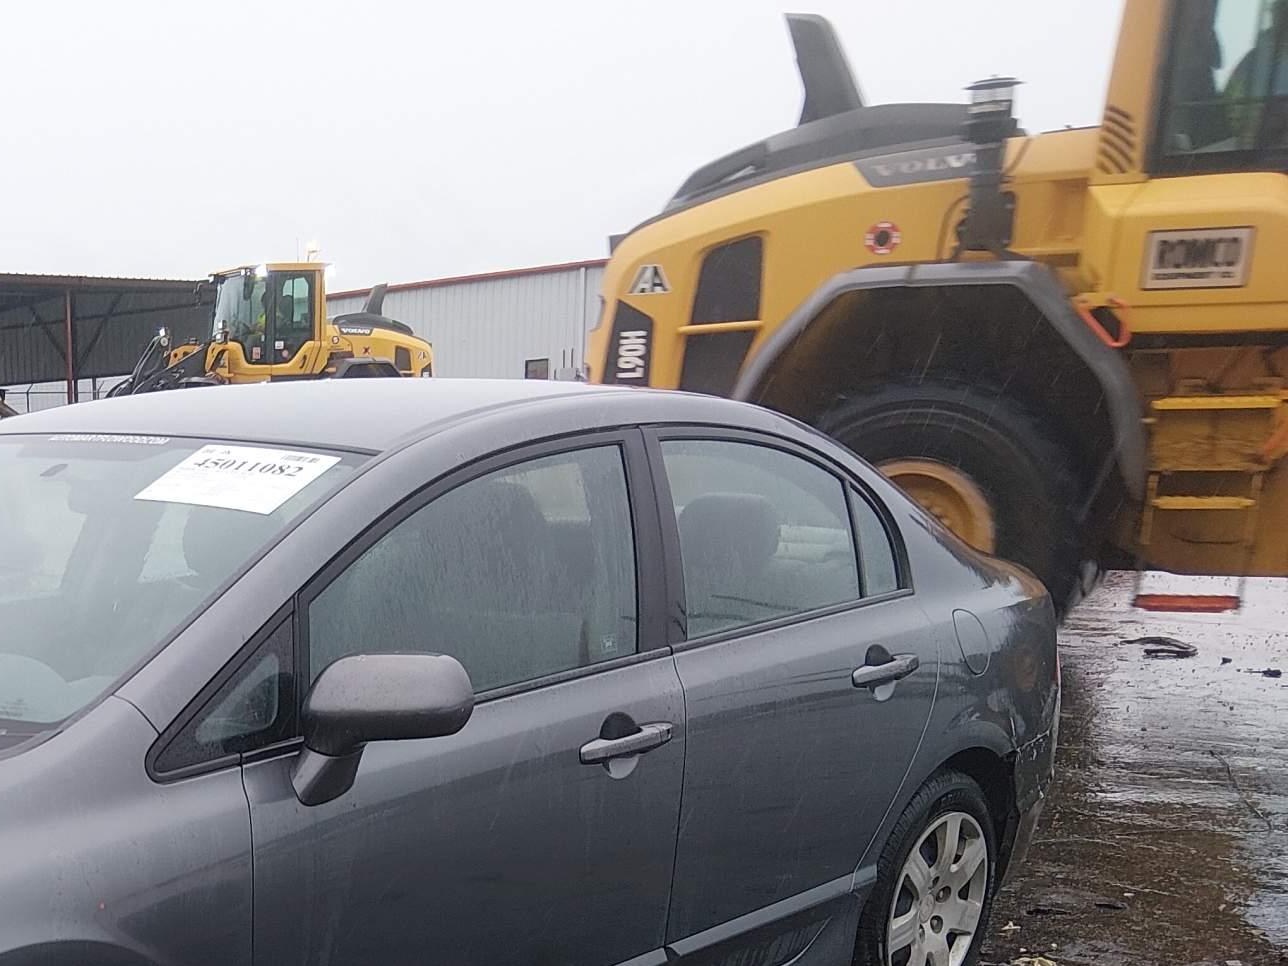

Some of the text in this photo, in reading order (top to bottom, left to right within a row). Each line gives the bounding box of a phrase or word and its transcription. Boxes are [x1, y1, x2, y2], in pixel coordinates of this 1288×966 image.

[870, 153, 977, 176] VOLV
[616, 330, 647, 378] L90H
[193, 458, 304, 477] 45011082
